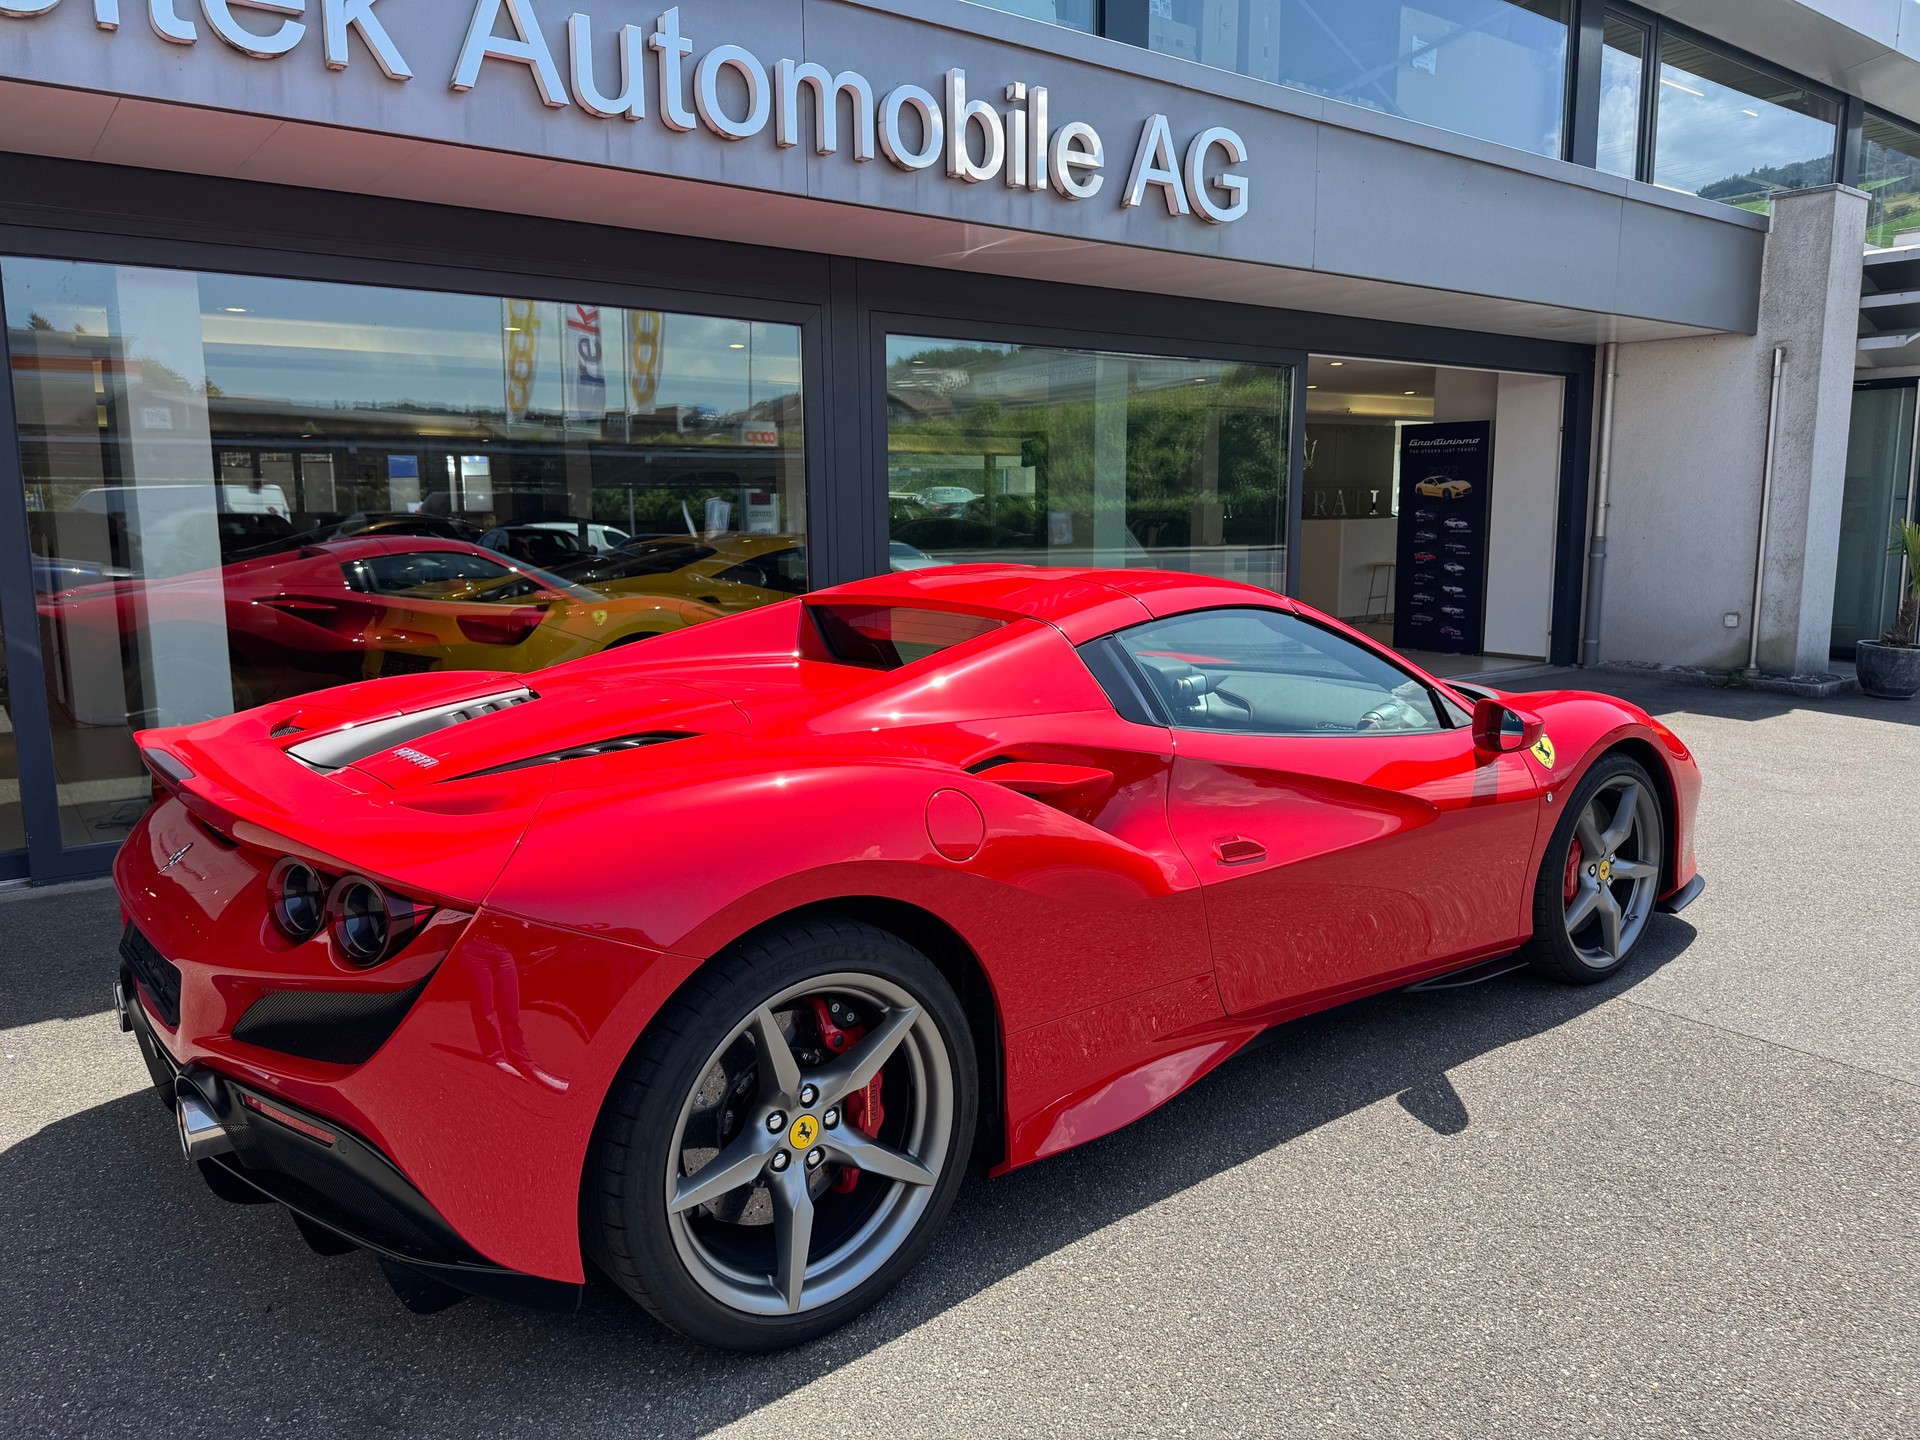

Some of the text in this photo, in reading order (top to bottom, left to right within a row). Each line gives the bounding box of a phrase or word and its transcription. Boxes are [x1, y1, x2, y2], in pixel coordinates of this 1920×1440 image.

[449, 0, 1105, 200] Automobile
[1120, 113, 1249, 225] AG
[1311, 489, 1380, 517] RATI
